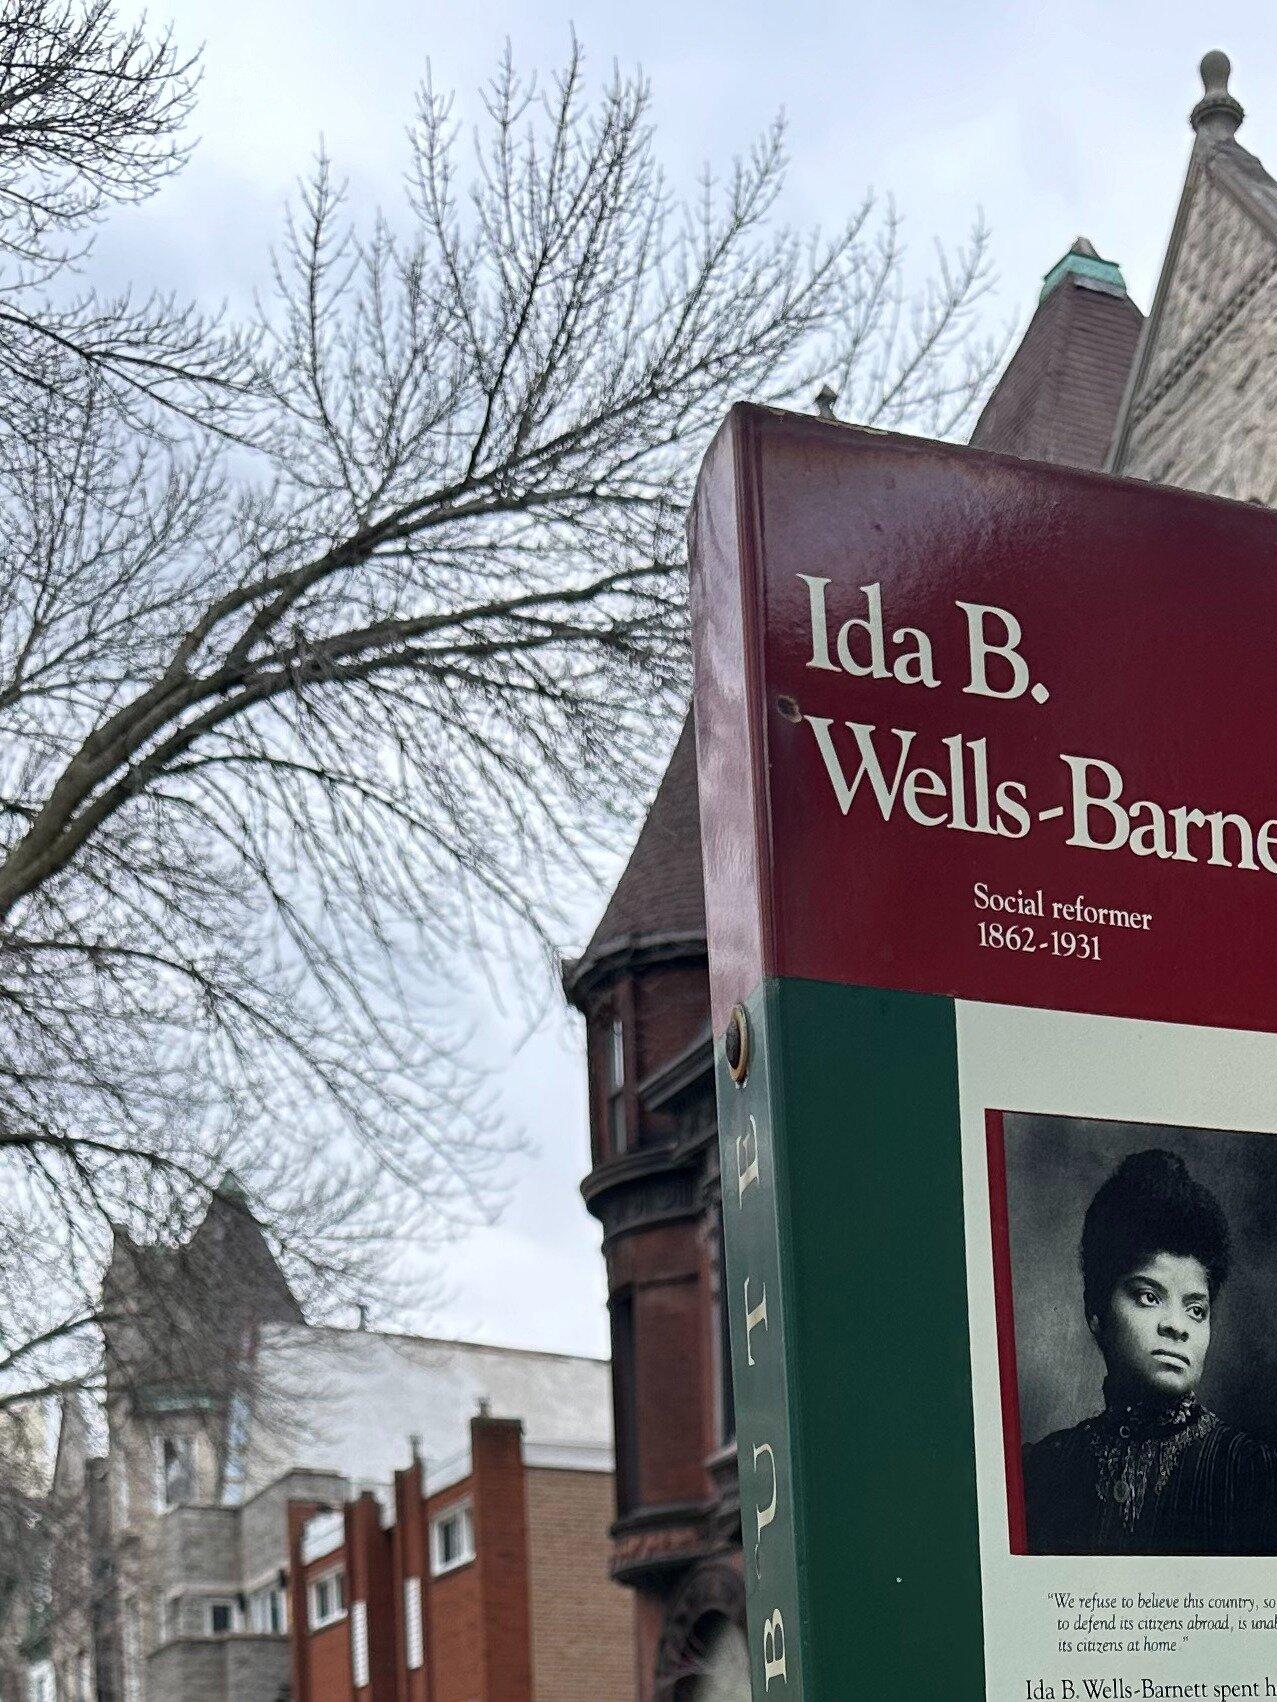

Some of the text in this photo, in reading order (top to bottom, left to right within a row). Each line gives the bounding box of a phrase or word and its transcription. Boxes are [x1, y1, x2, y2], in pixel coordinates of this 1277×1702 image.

[796, 572, 1049, 704] Ida B.
[974, 883, 1153, 931] Social reformer
[978, 921, 1103, 961] 1862-1931
[1079, 1592, 1117, 1612] refuse
[1121, 1597, 1134, 1609] to
[1138, 1592, 1179, 1609] believe
[1183, 1593, 1204, 1609] this
[1208, 1597, 1259, 1612] country,
[1263, 1597, 1276, 1609] so
[1057, 1618, 1070, 1631] to
[1073, 1614, 1116, 1634] defend
[1120, 1617, 1134, 1631] its
[1137, 1617, 1183, 1632] citizens
[1186, 1614, 1234, 1633] abroad,
[1238, 1616, 1247, 1631] is
[1058, 1638, 1072, 1652] its
[1076, 1638, 1123, 1654] citizens
[1127, 1640, 1140, 1652] at
[1025, 1679, 1055, 1700] Ida
[1061, 1679, 1080, 1700] B.
[1082, 1677, 1207, 1699] Wells-Barnett
[1213, 1682, 1260, 1702] spent
